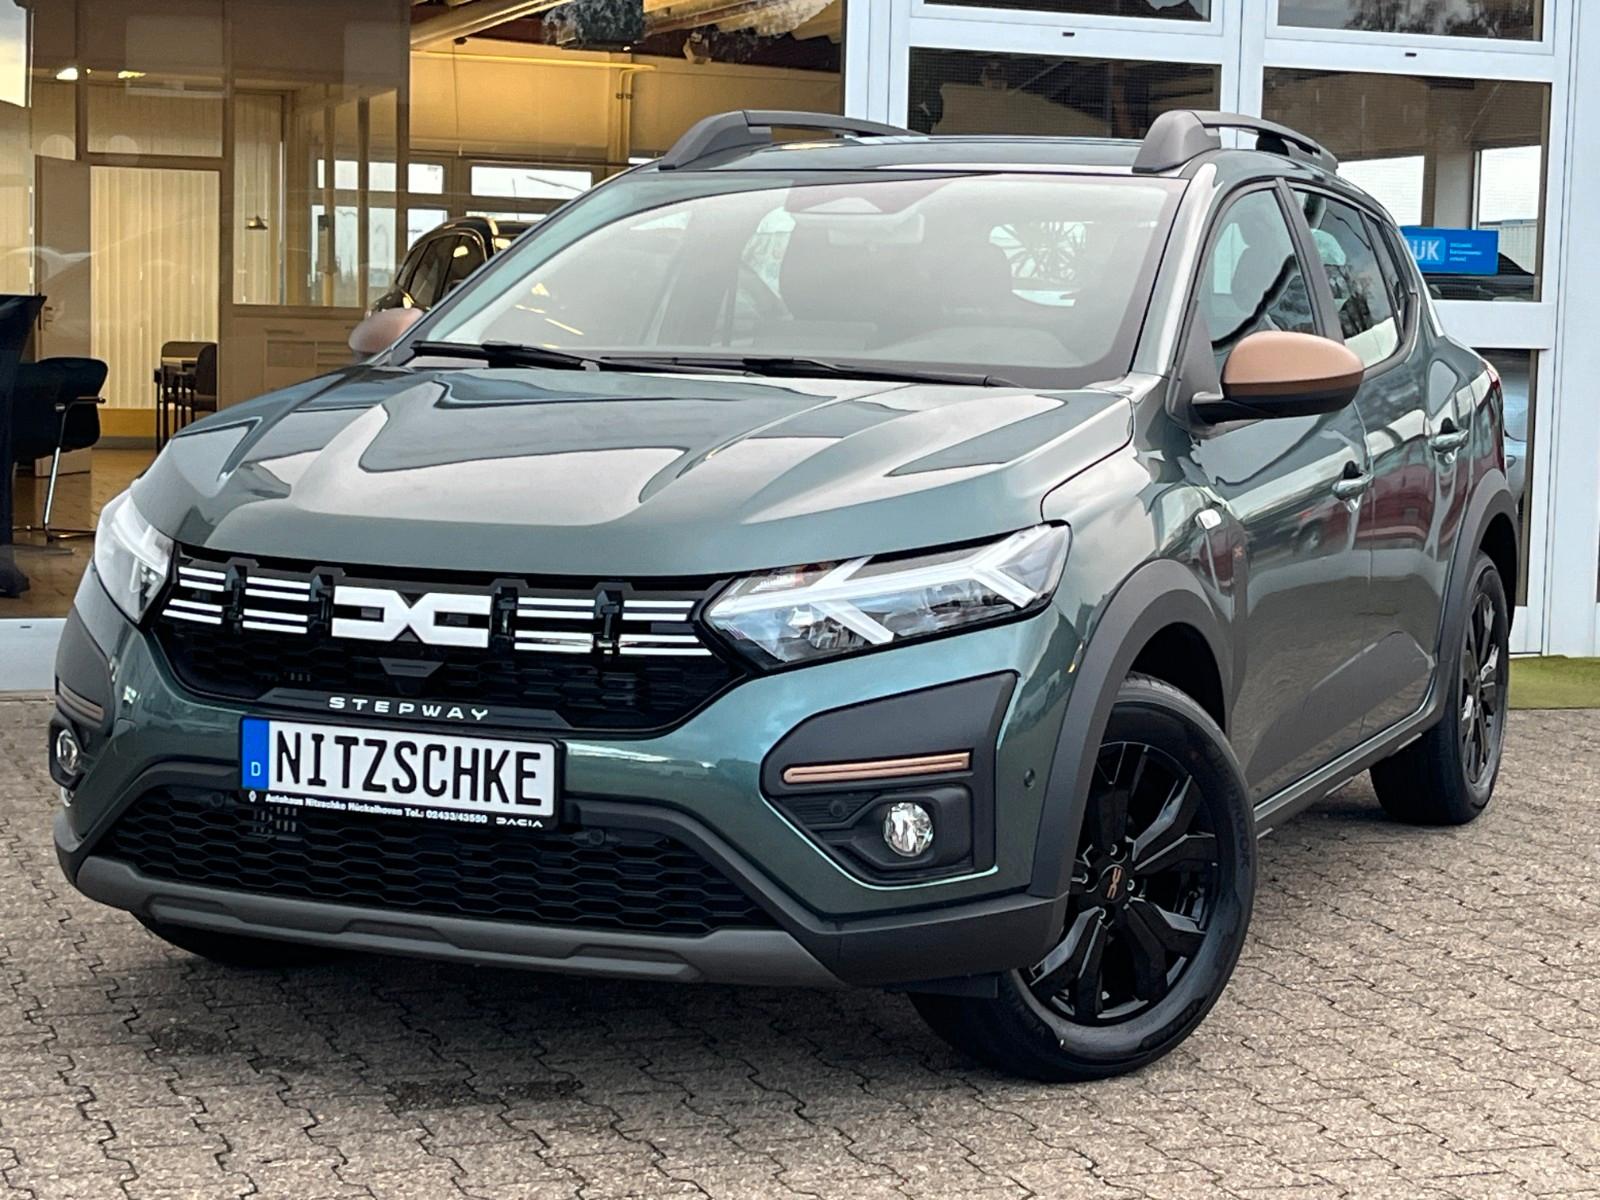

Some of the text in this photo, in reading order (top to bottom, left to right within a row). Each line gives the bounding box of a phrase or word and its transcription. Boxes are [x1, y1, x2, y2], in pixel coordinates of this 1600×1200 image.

[328, 696, 489, 721] STEPWAY
[250, 761, 261, 776] D
[276, 730, 542, 807] NITZSCHKE
[496, 816, 544, 829] DACIA
